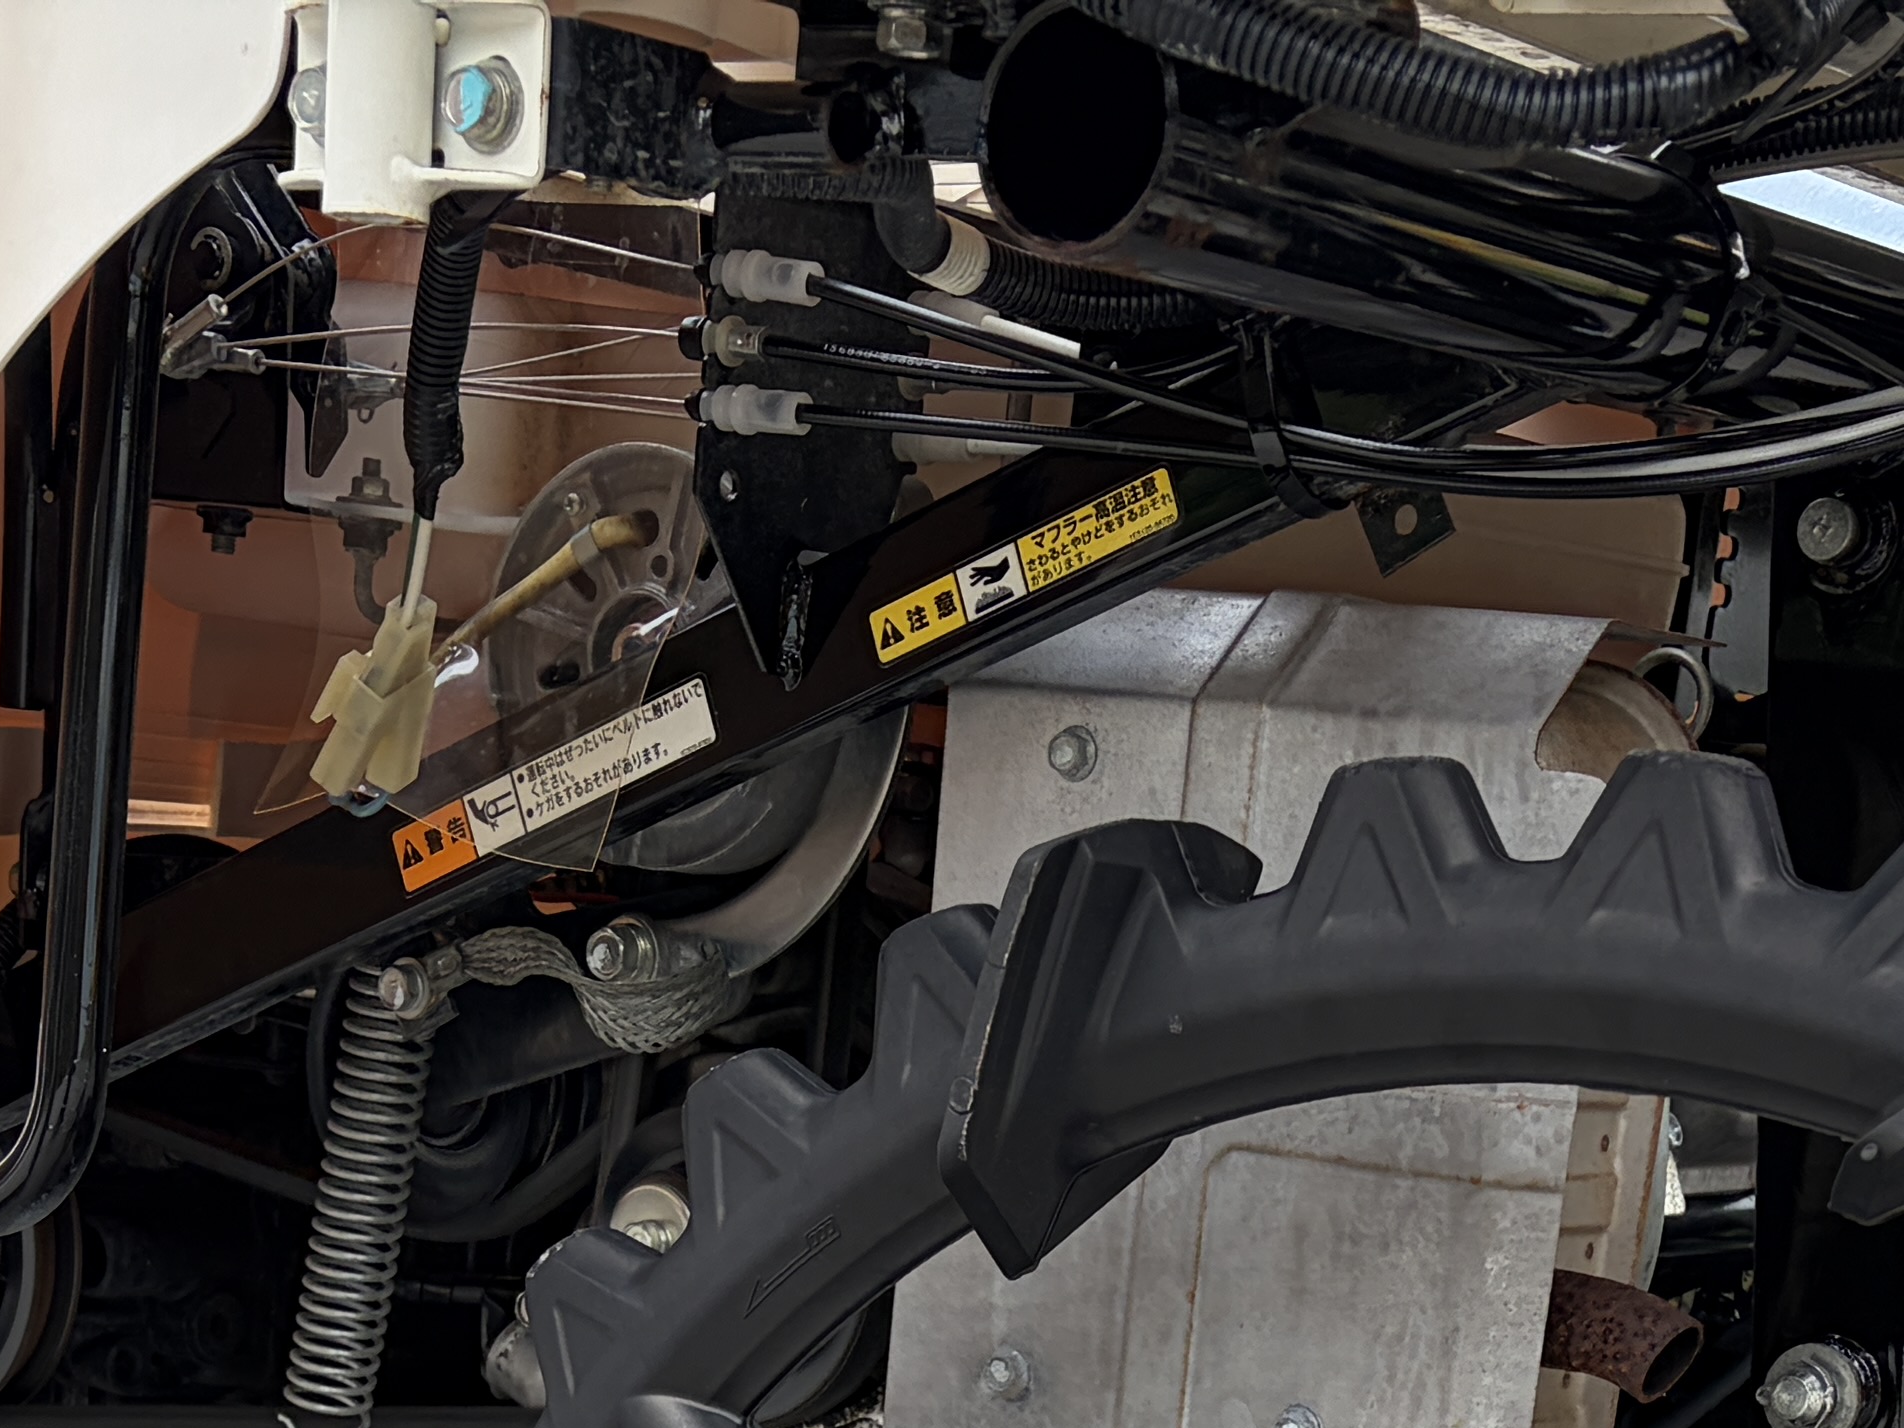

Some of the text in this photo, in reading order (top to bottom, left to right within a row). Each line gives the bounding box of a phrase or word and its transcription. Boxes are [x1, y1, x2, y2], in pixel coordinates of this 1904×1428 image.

[1026, 493, 1173, 572] さわるとやけどをするおそれ
[1031, 475, 1159, 549] マフラー高温注意
[1031, 551, 1092, 586] があります。
[906, 590, 958, 633] 注意
[526, 681, 704, 783] 運転中はぜったいにベルトに触れないで
[531, 769, 575, 797] ください。
[535, 742, 668, 817] ケガをするおそれがあります。
[424, 817, 468, 856] 警告
